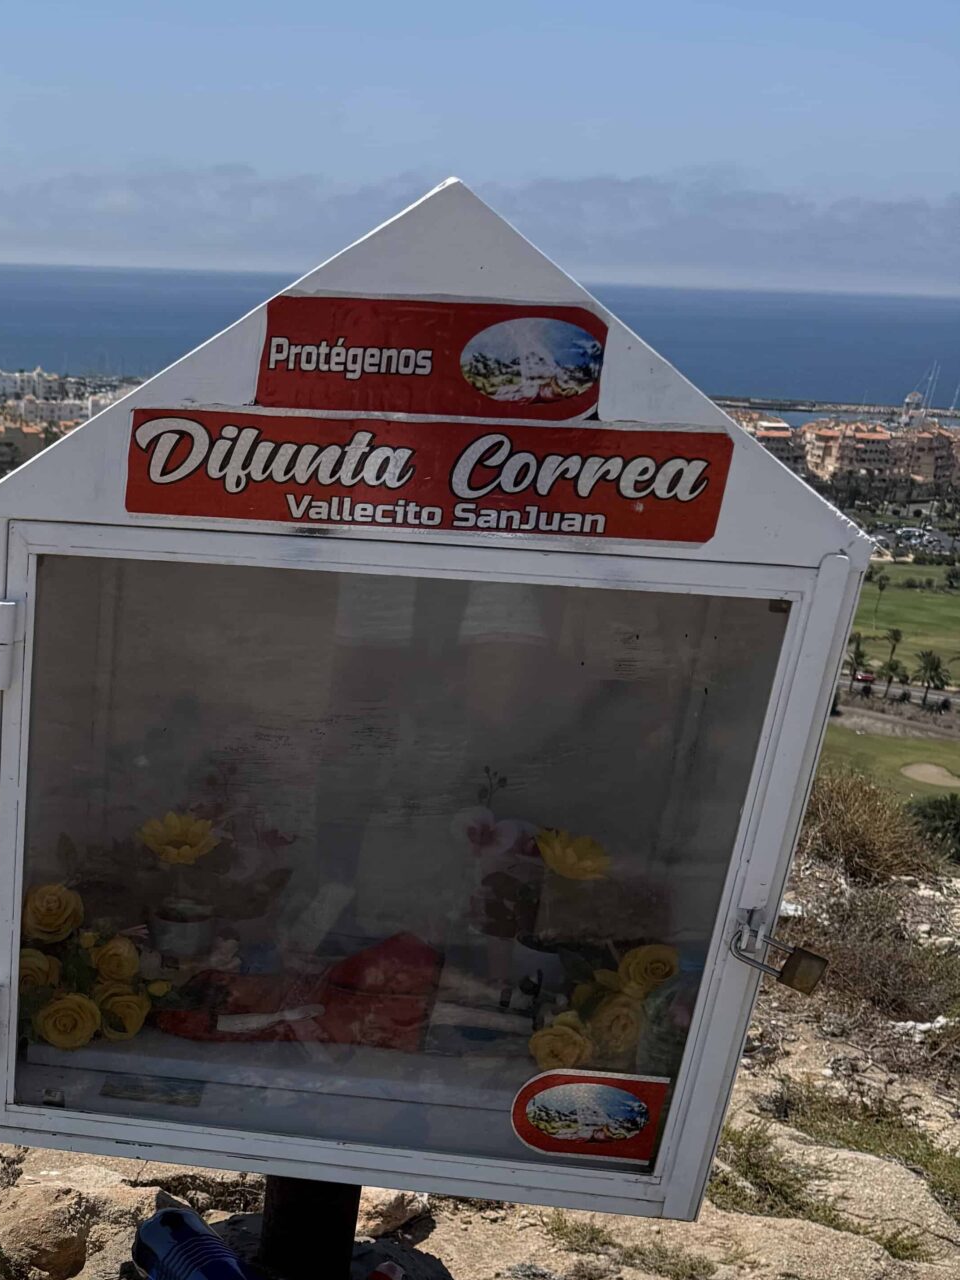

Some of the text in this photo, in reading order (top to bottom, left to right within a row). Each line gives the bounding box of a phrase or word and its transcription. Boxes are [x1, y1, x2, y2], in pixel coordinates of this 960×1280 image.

[268, 336, 434, 377] Protégenos
[135, 417, 710, 503] Difunta Correa
[285, 494, 442, 526] Vallecito
